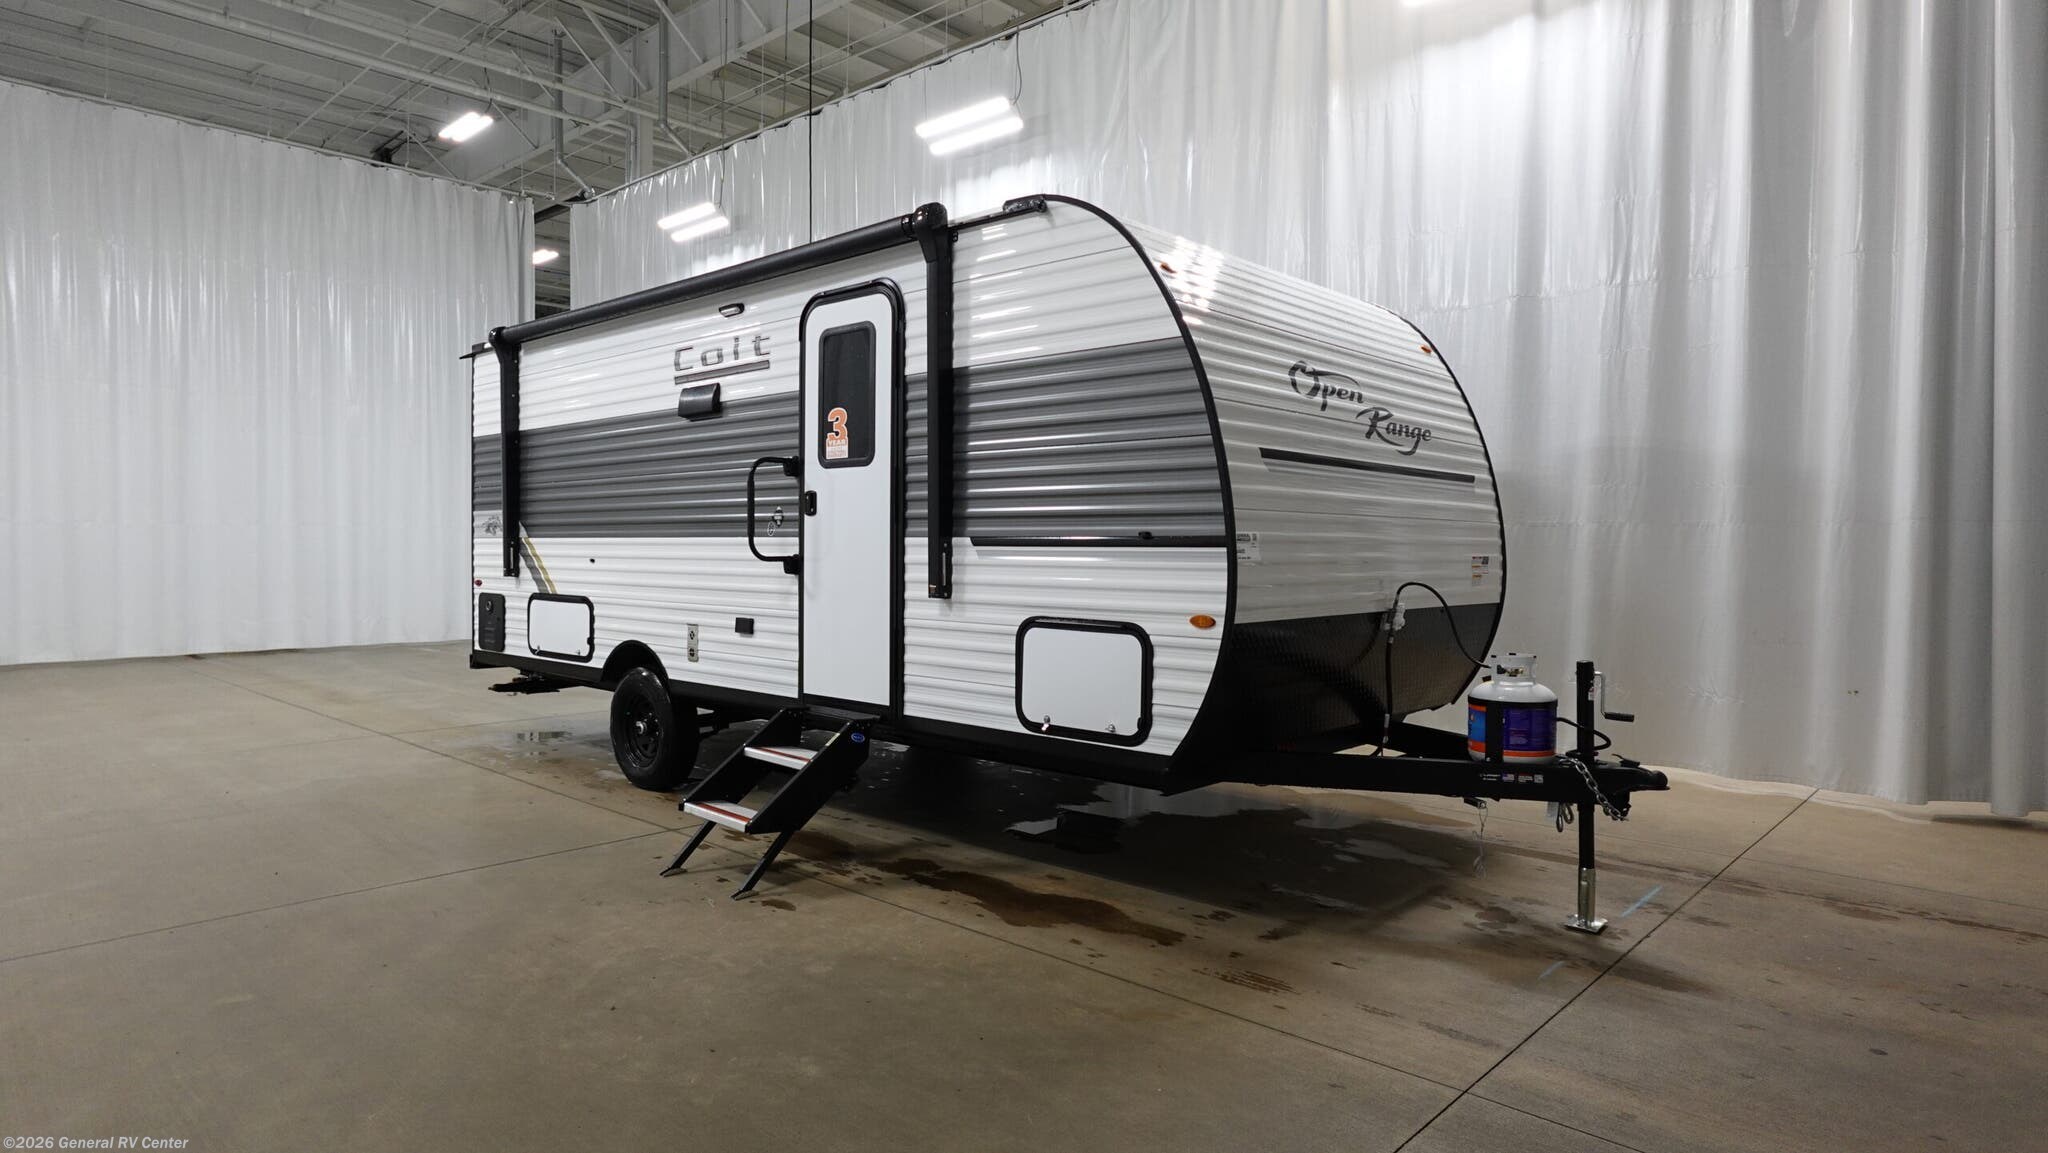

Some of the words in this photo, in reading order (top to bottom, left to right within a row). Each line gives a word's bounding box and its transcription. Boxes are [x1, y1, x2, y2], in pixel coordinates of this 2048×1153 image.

[1288, 360, 1364, 411] Open
[828, 407, 848, 439] 3
[1355, 406, 1432, 456] Range
